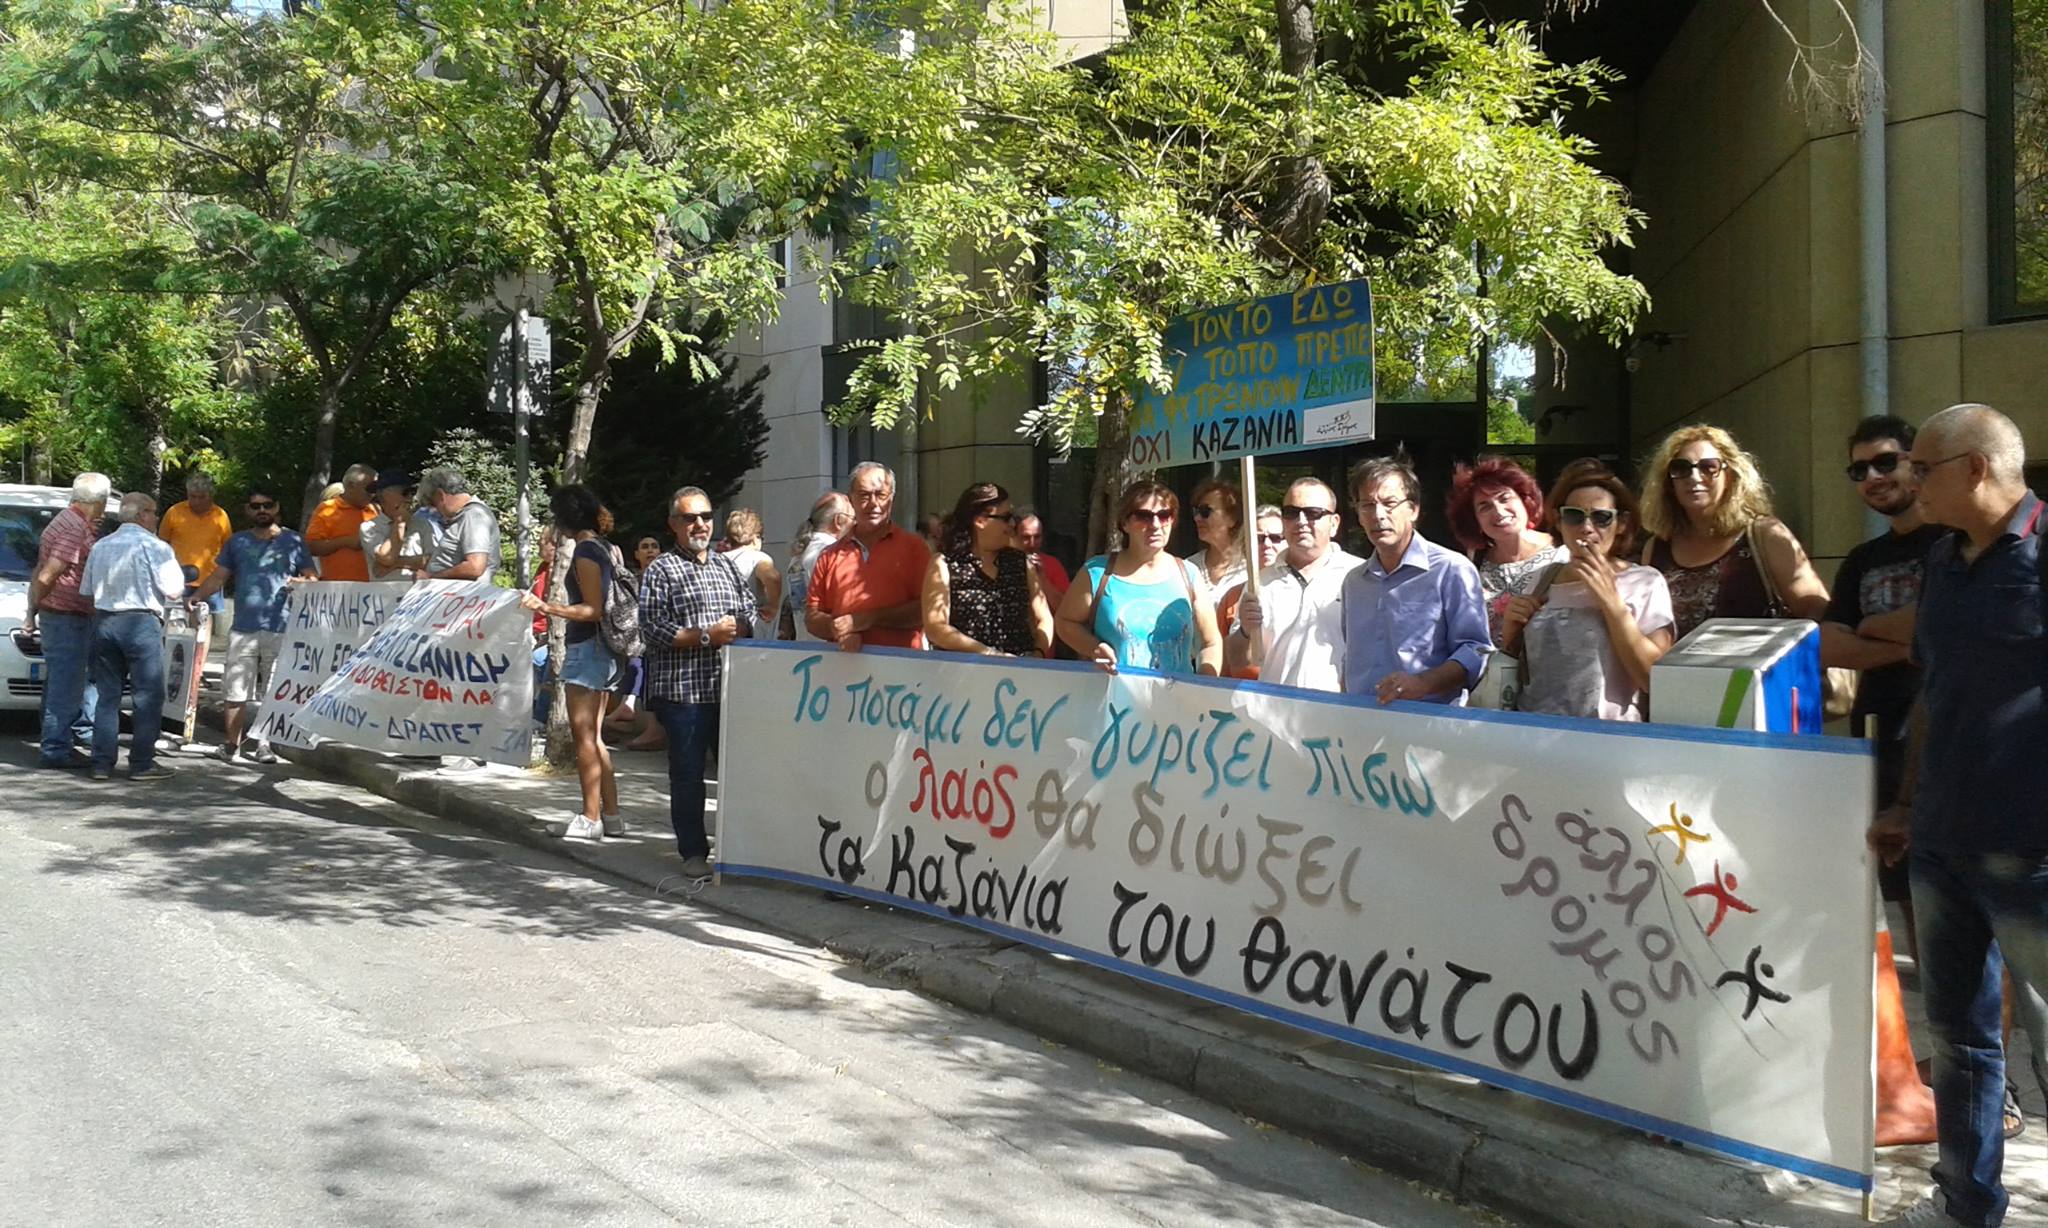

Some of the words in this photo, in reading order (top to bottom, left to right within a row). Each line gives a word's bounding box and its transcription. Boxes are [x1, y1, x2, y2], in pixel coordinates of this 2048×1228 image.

[1292, 285, 1355, 325] ΕΔΩ
[1203, 341, 1278, 382] ΤΟΠΟ
[1132, 430, 1171, 465] ΟΧΙ
[296, 591, 385, 631] ΑΝΑΚΛΗΣΗ
[292, 641, 324, 673] ΤΩΝ
[792, 654, 830, 723] Το
[846, 675, 971, 749] ποτάμι
[983, 678, 1071, 753] δεν
[1091, 702, 1273, 799] γυρίζει
[1302, 737, 1436, 817] πίσω
[910, 748, 1018, 839] λαός
[1027, 769, 1103, 850] θα
[1128, 780, 1363, 916] διώξει
[818, 815, 865, 883] τα
[1107, 881, 1216, 977] του
[1239, 916, 1599, 1081] θανάτου
